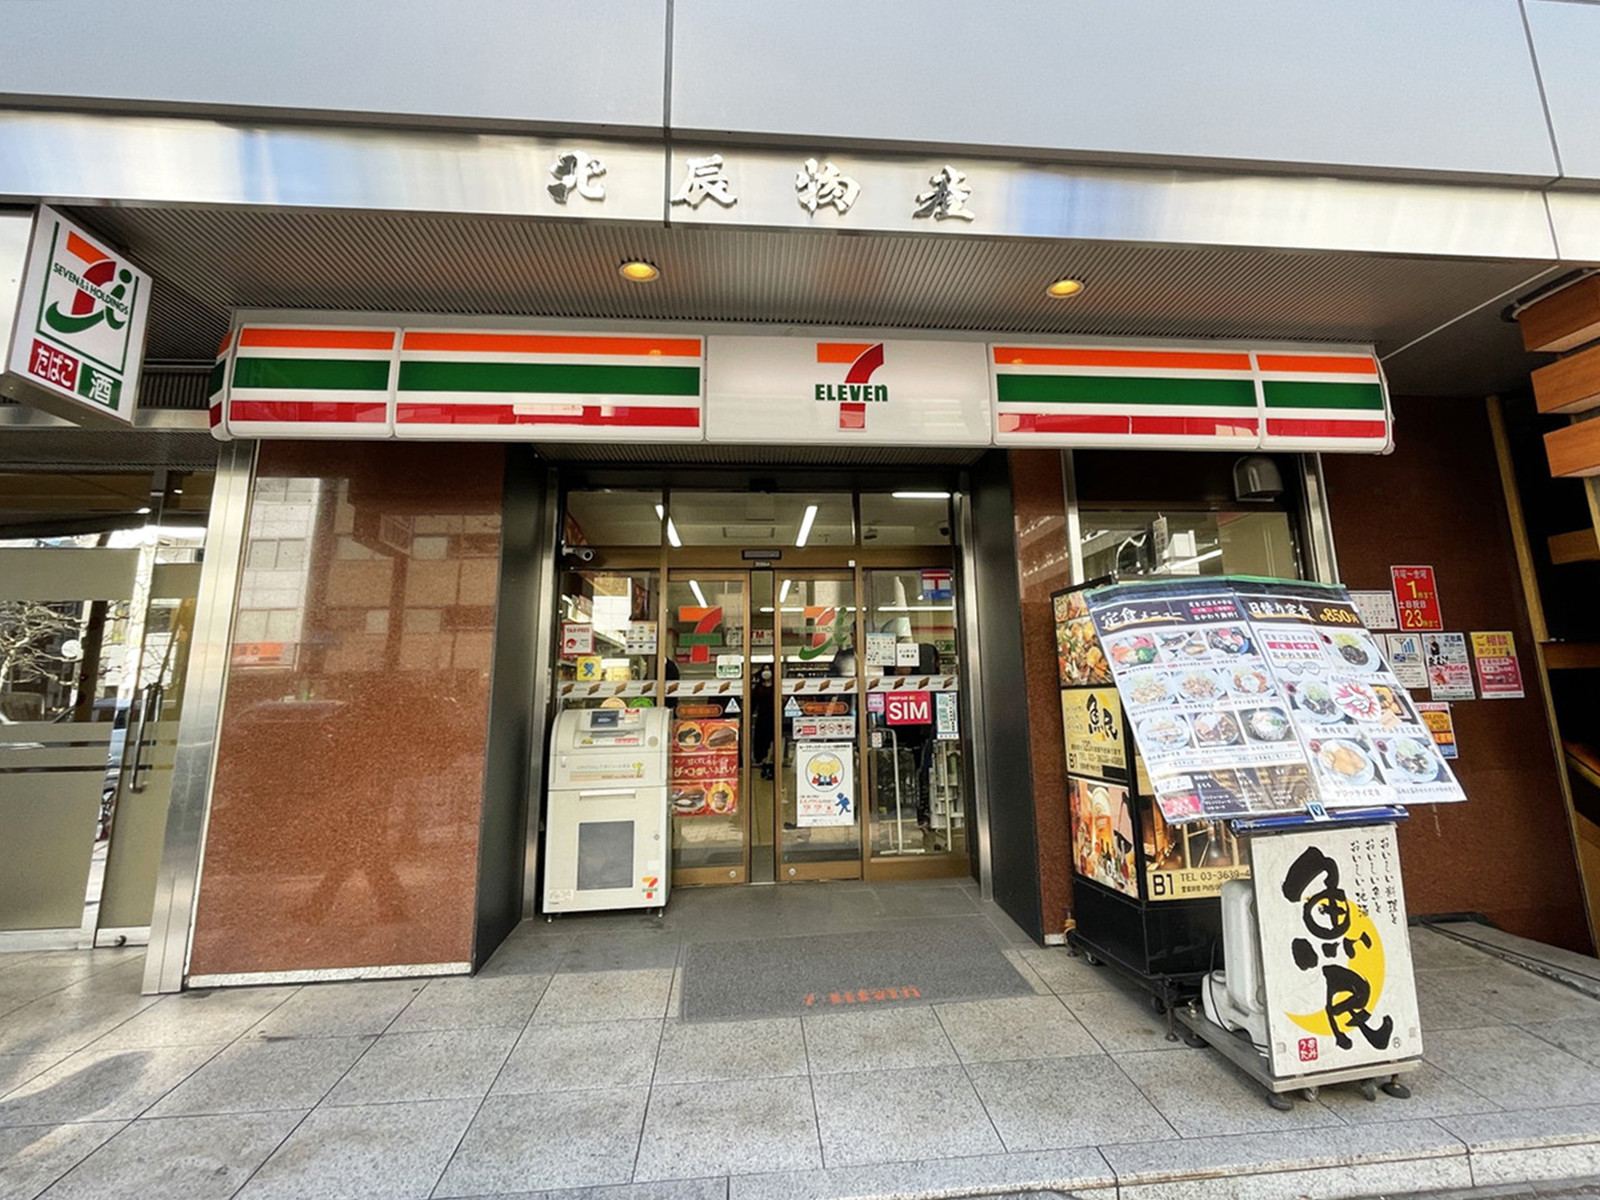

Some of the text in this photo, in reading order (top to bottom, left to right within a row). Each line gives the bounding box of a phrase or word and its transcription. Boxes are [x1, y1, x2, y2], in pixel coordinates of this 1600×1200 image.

[34, 345, 74, 387] たばこ
[88, 370, 114, 405] 酒
[1100, 606, 1182, 628] 定食メニュー
[1248, 602, 1311, 617] 日替り定食
[889, 702, 928, 720] SIM
[1153, 873, 1174, 896] B1
[1181, 873, 1197, 882] TEL
[1283, 846, 1393, 1051] 魚民
